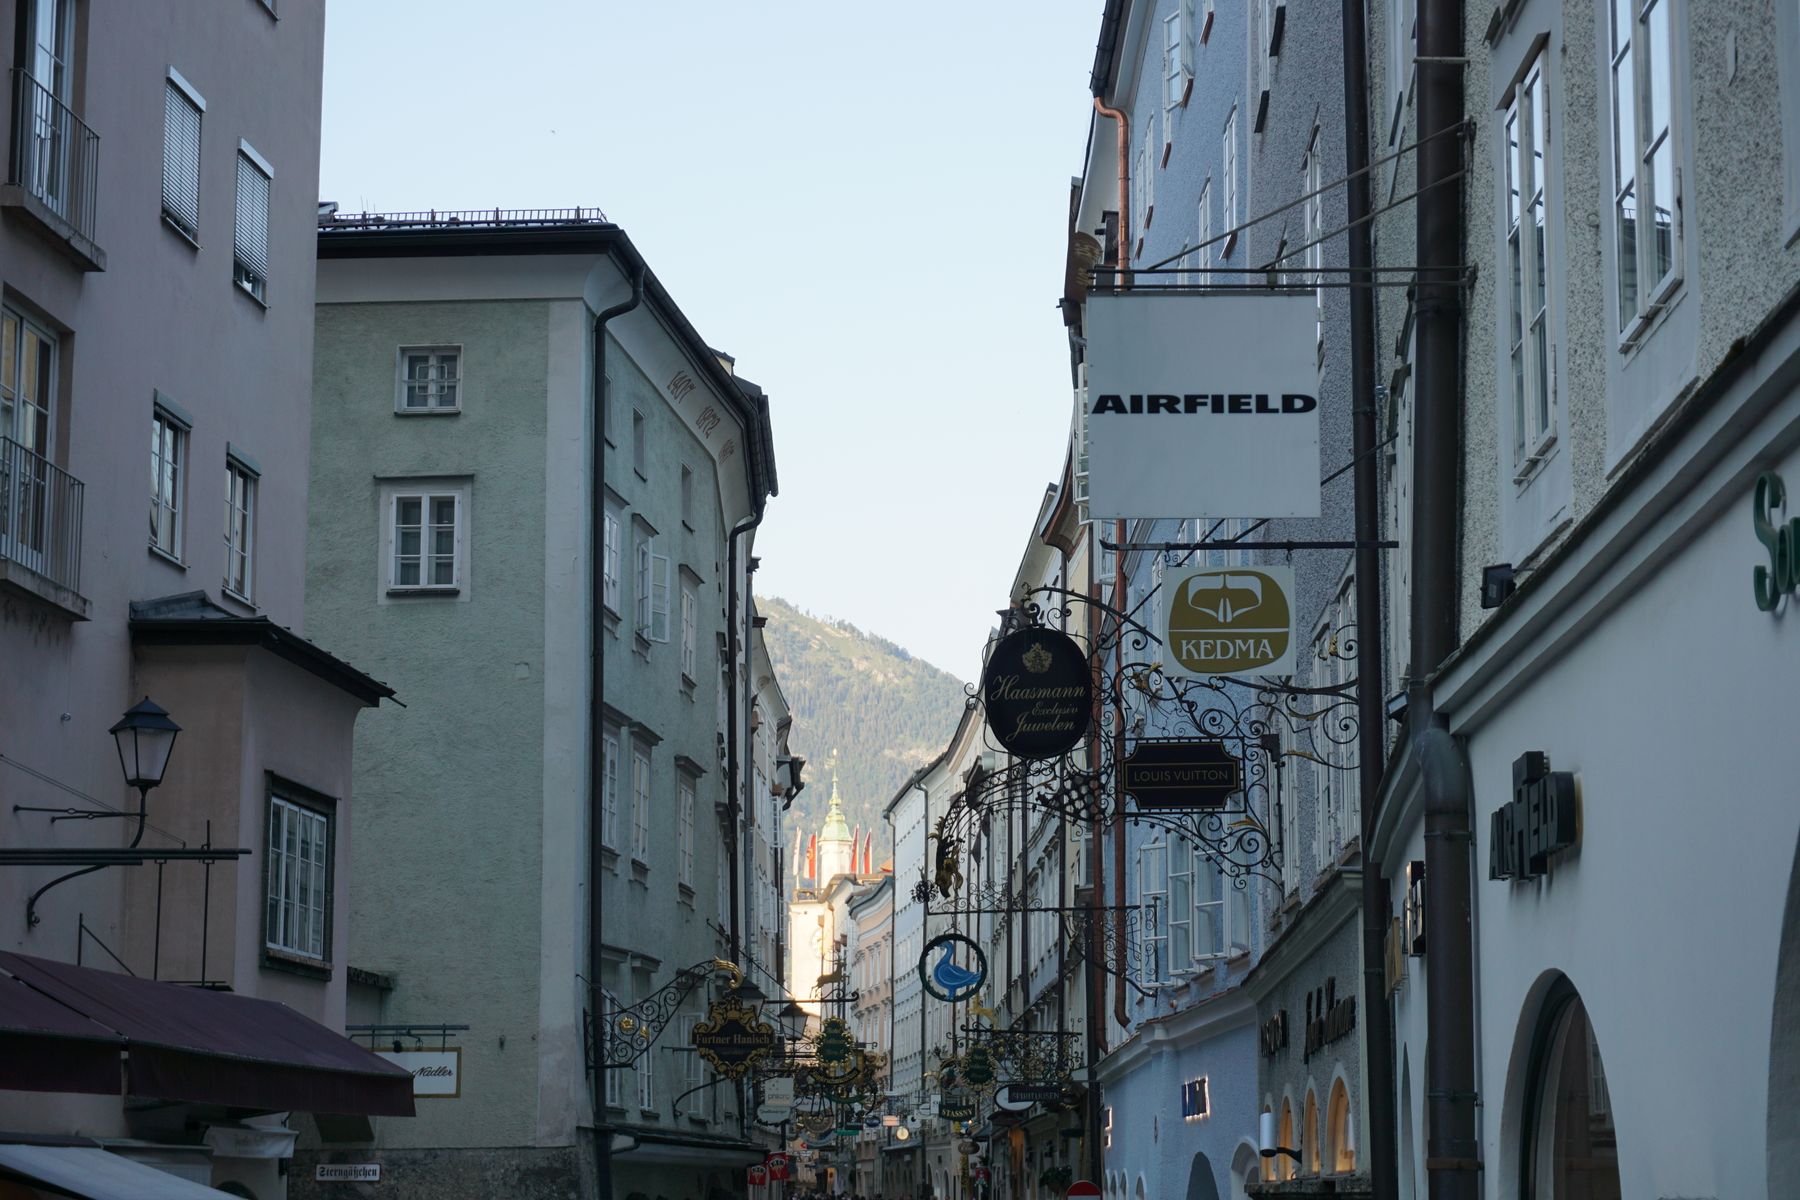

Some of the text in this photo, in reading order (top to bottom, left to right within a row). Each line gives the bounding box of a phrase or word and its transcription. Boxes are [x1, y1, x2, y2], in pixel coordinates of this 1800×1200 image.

[1091, 394, 1318, 414] AIRFIELD
[1180, 638, 1275, 661] KEDMA
[990, 674, 1086, 702] Haasmann
[1031, 701, 1079, 717] Exclusiv
[1005, 711, 1075, 743] Juwelen
[1133, 769, 1229, 782] LOUIS VUITTON
[696, 1033, 770, 1044] Furtner Hanisch
[411, 1065, 454, 1078] Nadler
